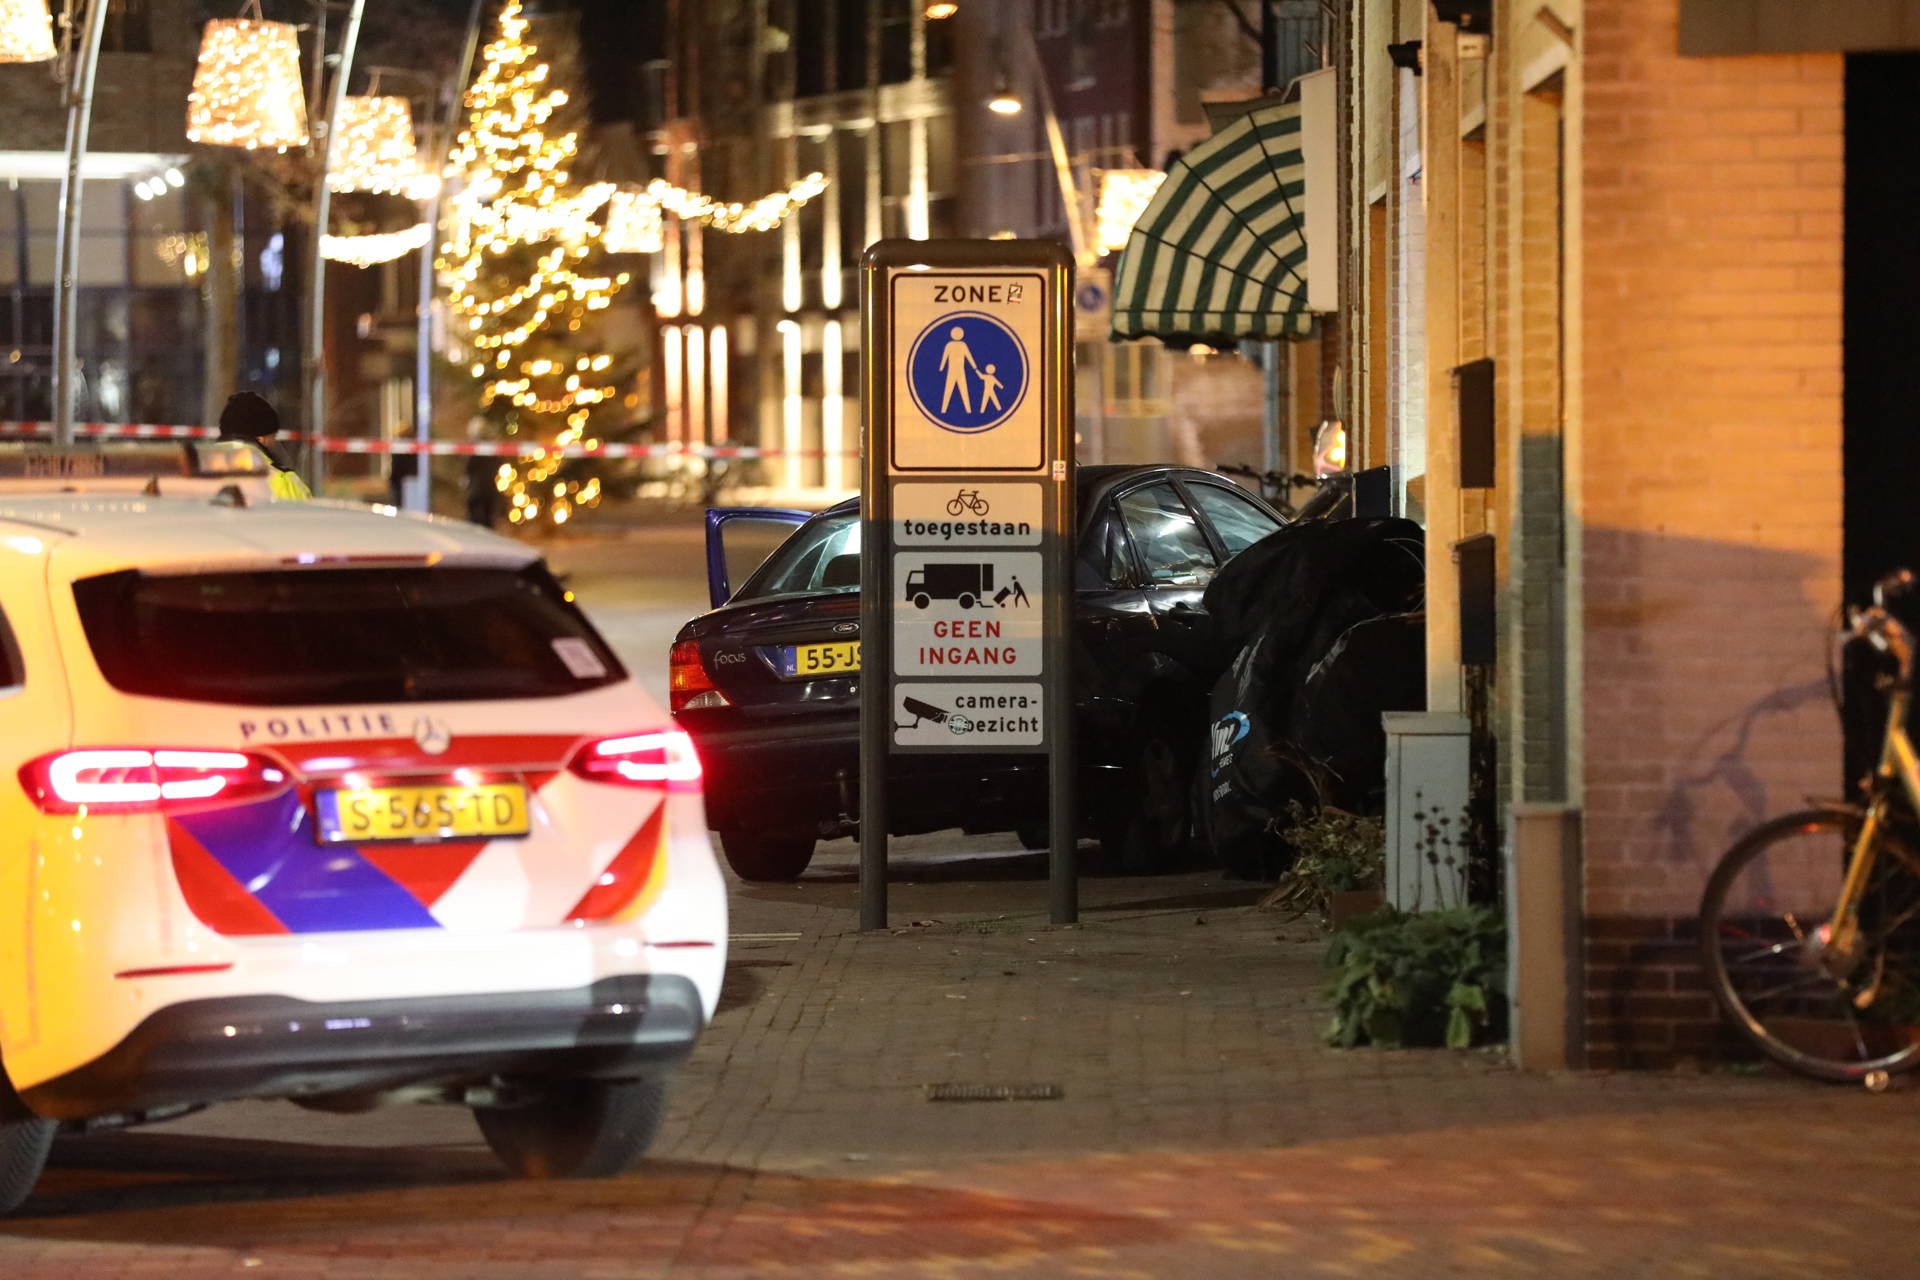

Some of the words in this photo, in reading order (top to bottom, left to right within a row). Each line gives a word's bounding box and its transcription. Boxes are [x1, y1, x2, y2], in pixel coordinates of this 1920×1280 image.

[934, 286, 1002, 303] ZONE
[904, 519, 1031, 540] toegestaan
[934, 621, 1001, 638] GEEN
[806, 645, 862, 670] 55-J
[919, 647, 1017, 665] INGANG
[955, 696, 1038, 708] camera-
[239, 714, 395, 739] POLITIE
[957, 716, 1038, 733] oezicht
[351, 794, 514, 831] S-565-TD
